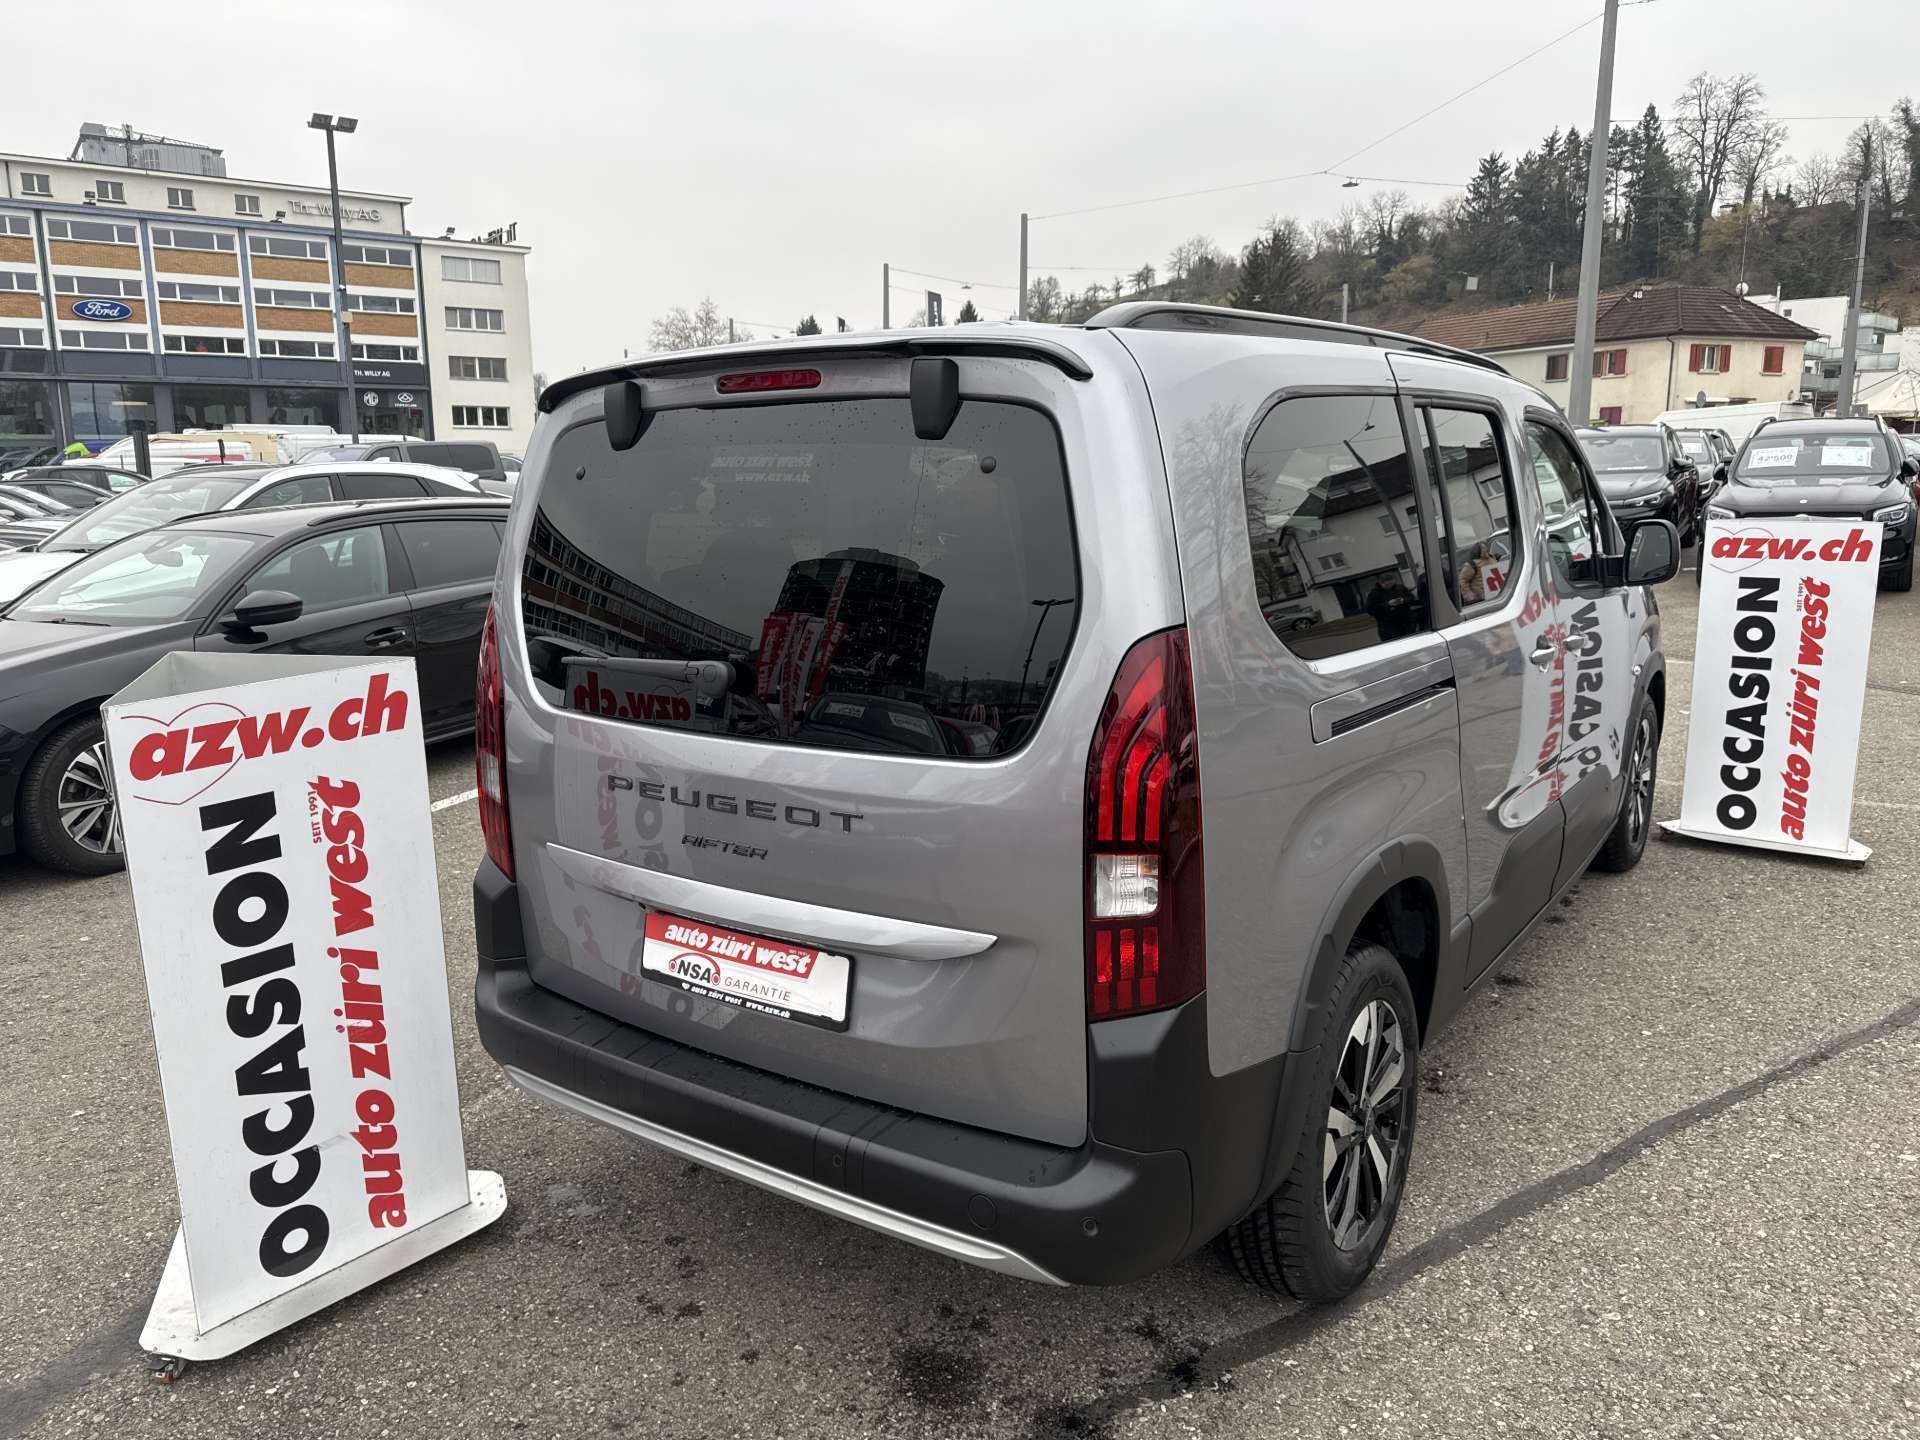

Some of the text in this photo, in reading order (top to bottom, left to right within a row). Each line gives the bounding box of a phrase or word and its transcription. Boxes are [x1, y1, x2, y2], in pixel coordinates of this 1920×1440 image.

[319, 203, 353, 221] Wly
[359, 208, 380, 221] AG
[84, 302, 120, 317] Ford
[354, 369, 364, 377] TH.
[363, 391, 379, 407] MG
[1711, 528, 1874, 562] azw.ch
[1716, 576, 1780, 830] OCCASION
[1781, 576, 1830, 840] auto züri west
[129, 672, 409, 781] azw.ch
[307, 790, 322, 844] SEIT 1991
[607, 774, 864, 834] PEUGEOT
[681, 834, 768, 861] RIFTER
[664, 923, 812, 975] auto züri west
[677, 959, 711, 984] NSA
[307, 775, 408, 1229] auto züri west
[691, 986, 707, 996] auto
[725, 995, 742, 1006] west
[745, 1001, 791, 1019] www.azw.ch
[724, 976, 792, 1002] GARANTIE
[199, 791, 330, 1278] OCCASION
